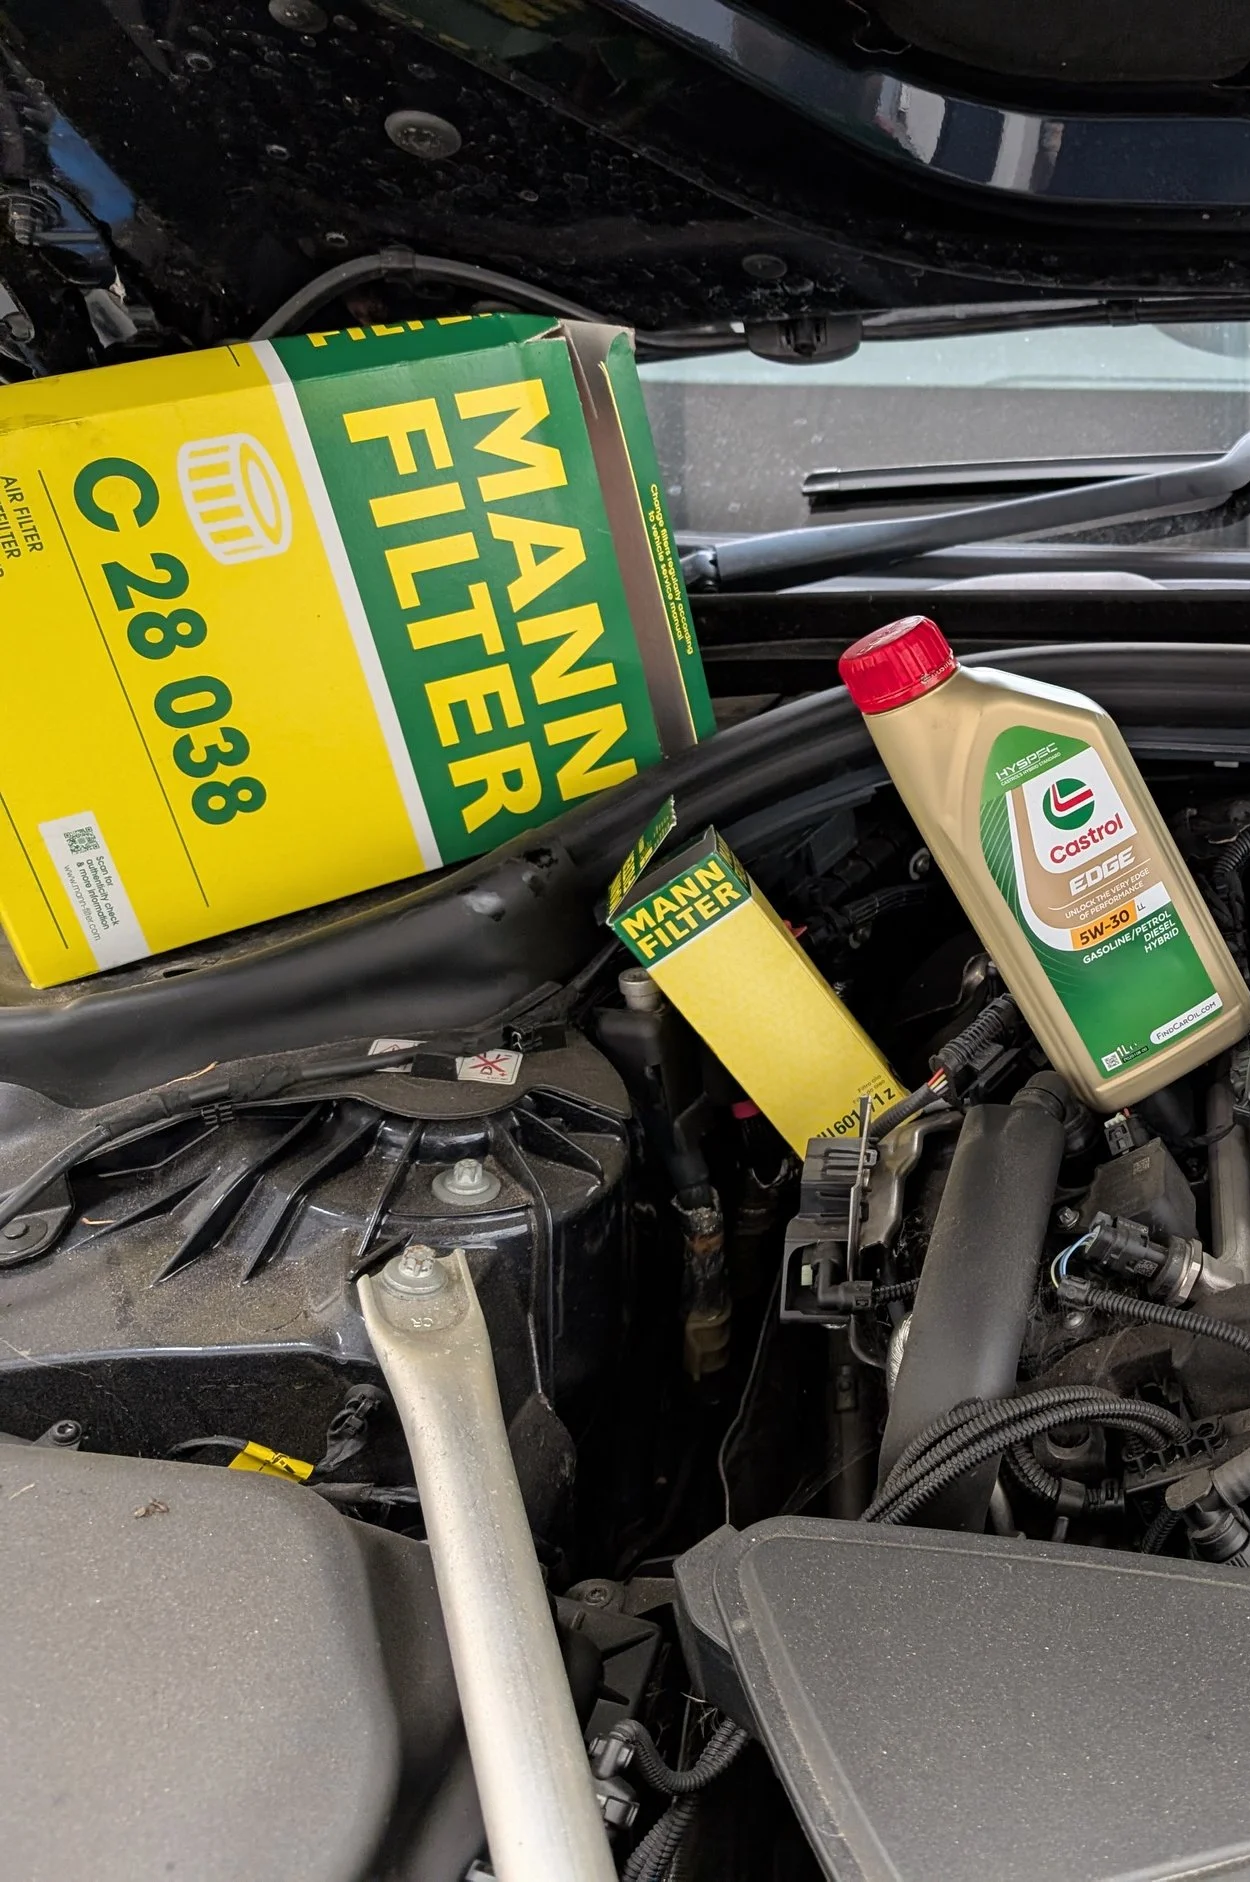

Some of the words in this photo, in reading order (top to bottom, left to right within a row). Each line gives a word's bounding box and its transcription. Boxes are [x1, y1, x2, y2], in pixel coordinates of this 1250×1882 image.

[0, 475, 24, 503] AIR
[13, 506, 44, 553] FILTER
[73, 457, 160, 532] C
[648, 510, 655, 523] to
[651, 522, 665, 562] vehicle
[454, 378, 638, 801] MANN
[650, 483, 665, 528] Change
[660, 527, 672, 556] filters
[666, 556, 682, 601] regularly
[677, 603, 694, 656] according
[660, 562, 674, 600] service
[101, 552, 208, 660] 28
[343, 397, 542, 834] FILTER
[670, 601, 683, 641] manual
[154, 675, 267, 826] 038
[995, 742, 1058, 780] HYSPEC
[1038, 752, 1062, 767] STANDARD
[1050, 812, 1124, 864] Castrol
[86, 858, 110, 901] authenticity
[104, 902, 120, 927] check
[95, 855, 109, 876] Scan
[104, 875, 114, 887] for
[1065, 898, 1097, 920] UNLOCK
[1095, 889, 1112, 902] THE
[1110, 880, 1131, 895] VERY
[1130, 867, 1151, 883] EDGE
[1068, 845, 1136, 896] EDGE
[64, 864, 102, 942] www.mann-filter.com
[79, 868, 92, 889] more
[88, 888, 110, 931] information
[620, 860, 727, 940] MANN
[636, 881, 742, 960] FILTER
[1079, 911, 1093, 922] OF
[1090, 881, 1145, 915] PERFORMANCE
[1079, 909, 1130, 946] 5W-30
[1136, 902, 1147, 912] LL
[1082, 910, 1172, 965] GASOLINE/PETROL
[1143, 919, 1176, 943] DIESEL
[1144, 927, 1180, 954] HYBRID
